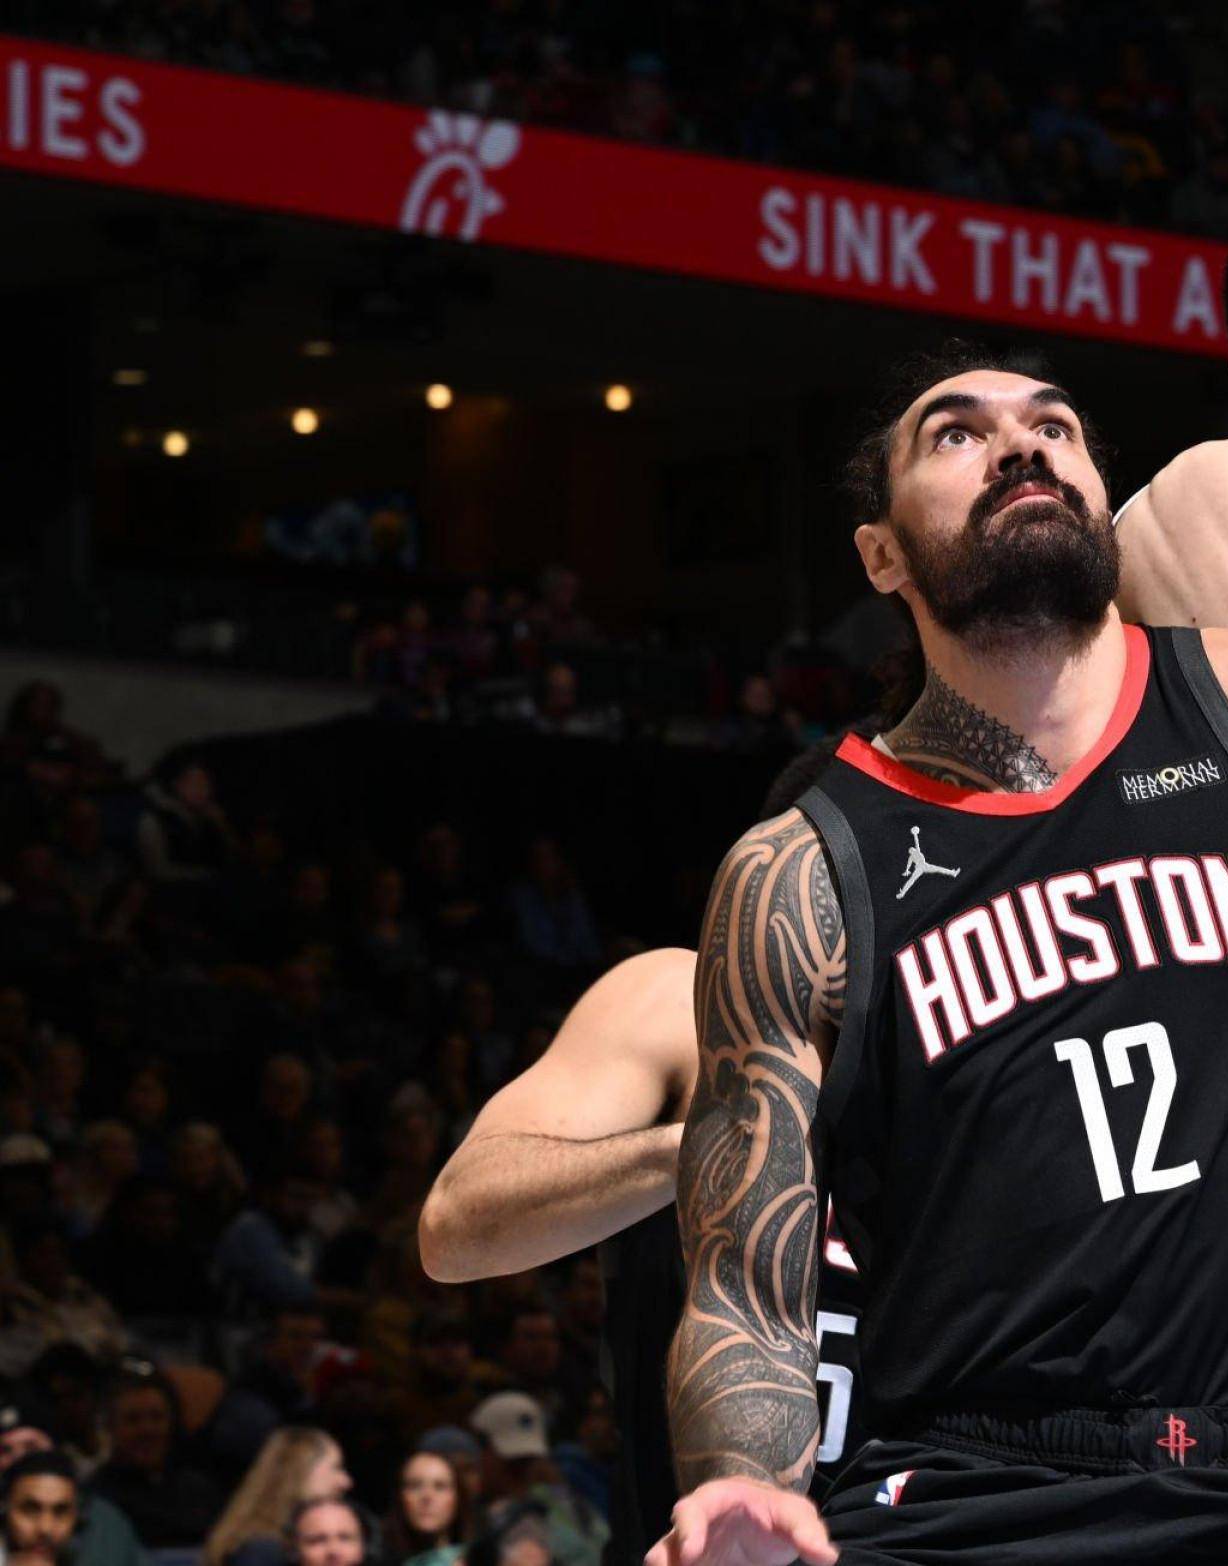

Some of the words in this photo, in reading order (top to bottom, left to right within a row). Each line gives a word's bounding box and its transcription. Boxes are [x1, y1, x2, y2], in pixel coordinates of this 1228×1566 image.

[0, 59, 146, 167] IES
[758, 187, 936, 295] SINK
[961, 219, 1150, 324] THAT
[1174, 254, 1220, 337] A
[1122, 758, 1219, 791] MEMORIAL
[1124, 770, 1221, 800] HERMANN
[1054, 1021, 1202, 1203] 12
